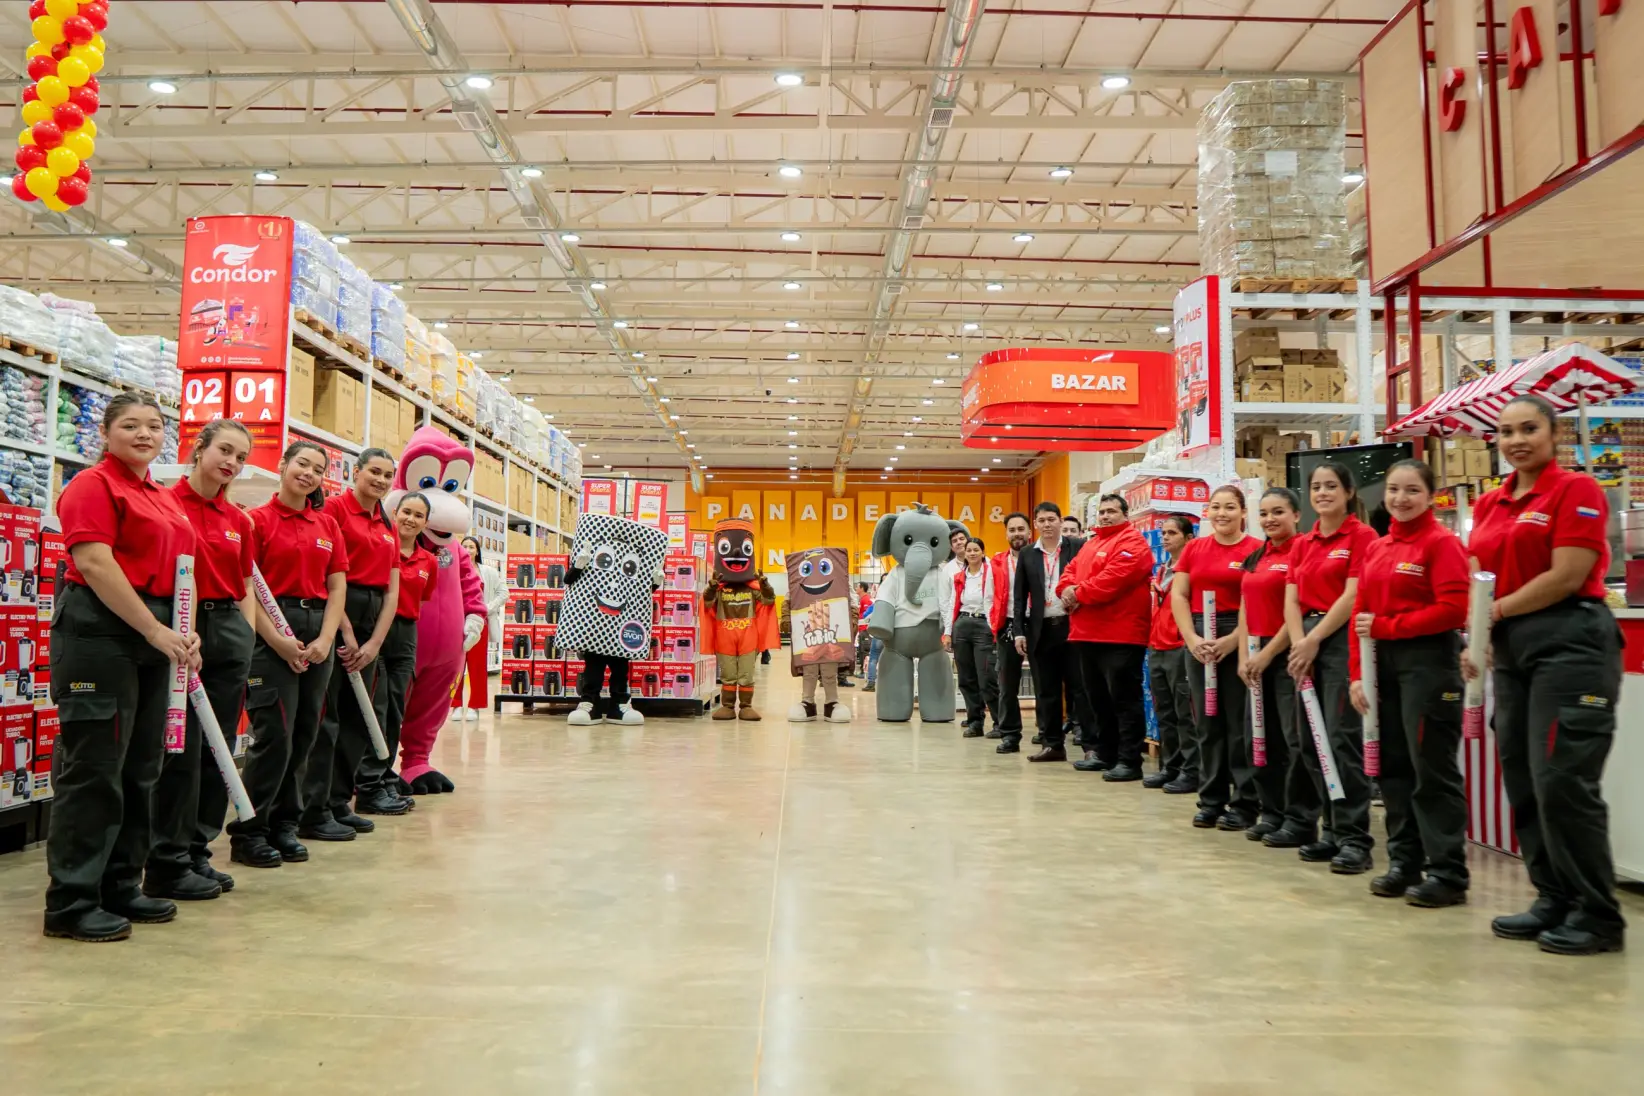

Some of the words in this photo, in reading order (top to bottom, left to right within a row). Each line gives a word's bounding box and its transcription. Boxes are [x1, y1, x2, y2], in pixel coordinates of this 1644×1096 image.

[190, 265, 277, 284] Condor
[185, 378, 222, 405] 02
[235, 377, 275, 404] 01
[1051, 373, 1127, 391] BAZAR
[184, 408, 195, 421] A
[259, 408, 272, 420] A
[989, 505, 1005, 523] &
[178, 588, 192, 638] onfetti
[268, 605, 284, 629] Party
[623, 631, 643, 641] avon
[172, 664, 188, 693] Lan
